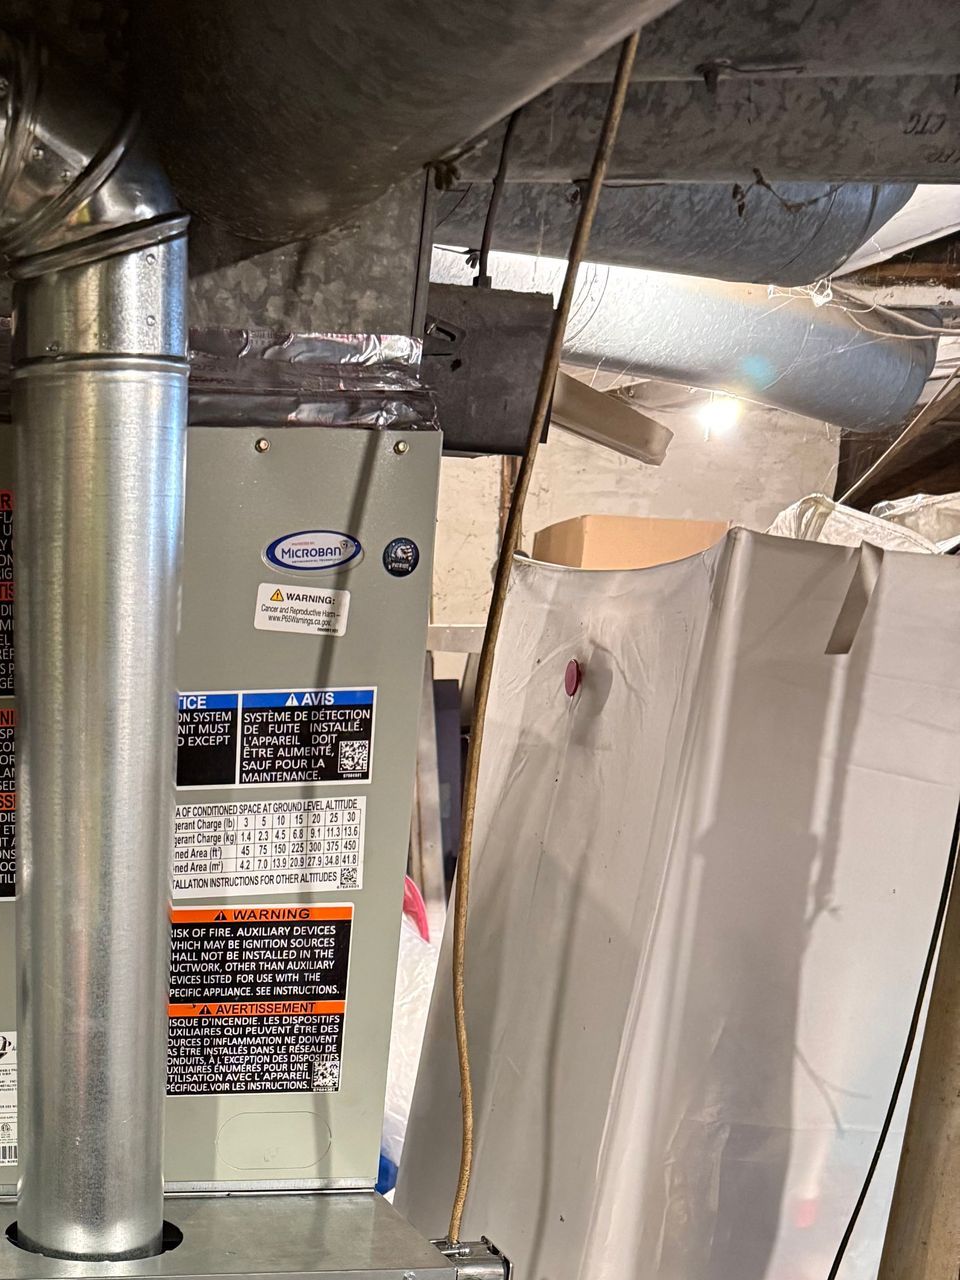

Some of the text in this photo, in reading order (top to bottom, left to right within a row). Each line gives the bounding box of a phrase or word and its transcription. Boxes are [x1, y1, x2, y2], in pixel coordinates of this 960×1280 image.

[287, 593, 336, 604] WARNING:
[261, 604, 278, 612] Cancer
[279, 606, 289, 614] and
[291, 607, 321, 616] Reproductive
[301, 692, 334, 705] AVIS
[193, 712, 232, 722] SYSTEM
[244, 709, 370, 723] SYSTÈME DE DÉTECTION
[199, 724, 230, 733] MUST
[245, 719, 363, 734] DE FUITE INSTALLÉ.
[188, 735, 230, 746] EXCEPT
[244, 734, 338, 746] L'APPAREIL DOIT
[244, 745, 334, 758] ÊTRE ALIMENTÉ,
[0, 755, 15, 765] OR
[243, 759, 325, 770] SAUF POUR LA
[242, 771, 320, 782] MAINTENANCE.
[182, 807, 191, 816] OF
[193, 804, 237, 816] CONDITIONED
[239, 803, 261, 814] SPACE
[273, 802, 302, 812] GROUND
[304, 801, 324, 811] LEVEL
[326, 799, 357, 809] ALTITUDE
[197, 812, 355, 831] Charge 10 15 20 25 30
[4, 825, 15, 834] ET
[197, 826, 358, 845] Charge (kg) 1.4 2.3 4.5 6.8 9.1 11.3 13.6
[191, 848, 207, 858] Area
[275, 844, 286, 854] 150
[291, 843, 304, 853] 225
[309, 842, 321, 852] 300
[326, 841, 339, 851] 375
[344, 840, 356, 849] 450
[190, 862, 207, 872] Area
[240, 860, 250, 869] 4.2
[258, 859, 267, 869] 7.0
[273, 858, 286, 868] 13.9
[290, 857, 304, 866] 20.9
[307, 856, 322, 866] 27.9
[325, 855, 339, 865] 34.8
[342, 854, 356, 864] 41.8
[210, 872, 337, 887] INSTRUCTIONS FOR OTHER ALTITUDES
[234, 909, 310, 920] WARNING
[192, 926, 336, 937] OF FIRE. AUXILIARY DEVICES
[204, 938, 335, 949] MAY BE IGNITION SOURCES
[201, 949, 334, 960] NOT BE INSTALLED IN THE
[225, 960, 335, 971] OTHER THAN AUXILIARY
[204, 973, 320, 984] LISTED FOR USE WITH THE
[204, 985, 340, 996] APPLIANCE. SEE INSTRUCTIONS.
[216, 1003, 316, 1014] AVERTISSEMENT
[202, 1016, 340, 1026] D'INCENDIE. DISPOSITIFS
[246, 1025, 339, 1035] PEUVENT DES
[299, 1035, 337, 1043] DOIVENT
[289, 1043, 322, 1053] RÉSEAU
[291, 1053, 339, 1062] DISPOSITIFS
[264, 1063, 288, 1071] POUR
[248, 1080, 310, 1090] INSTRUCTIONS.
